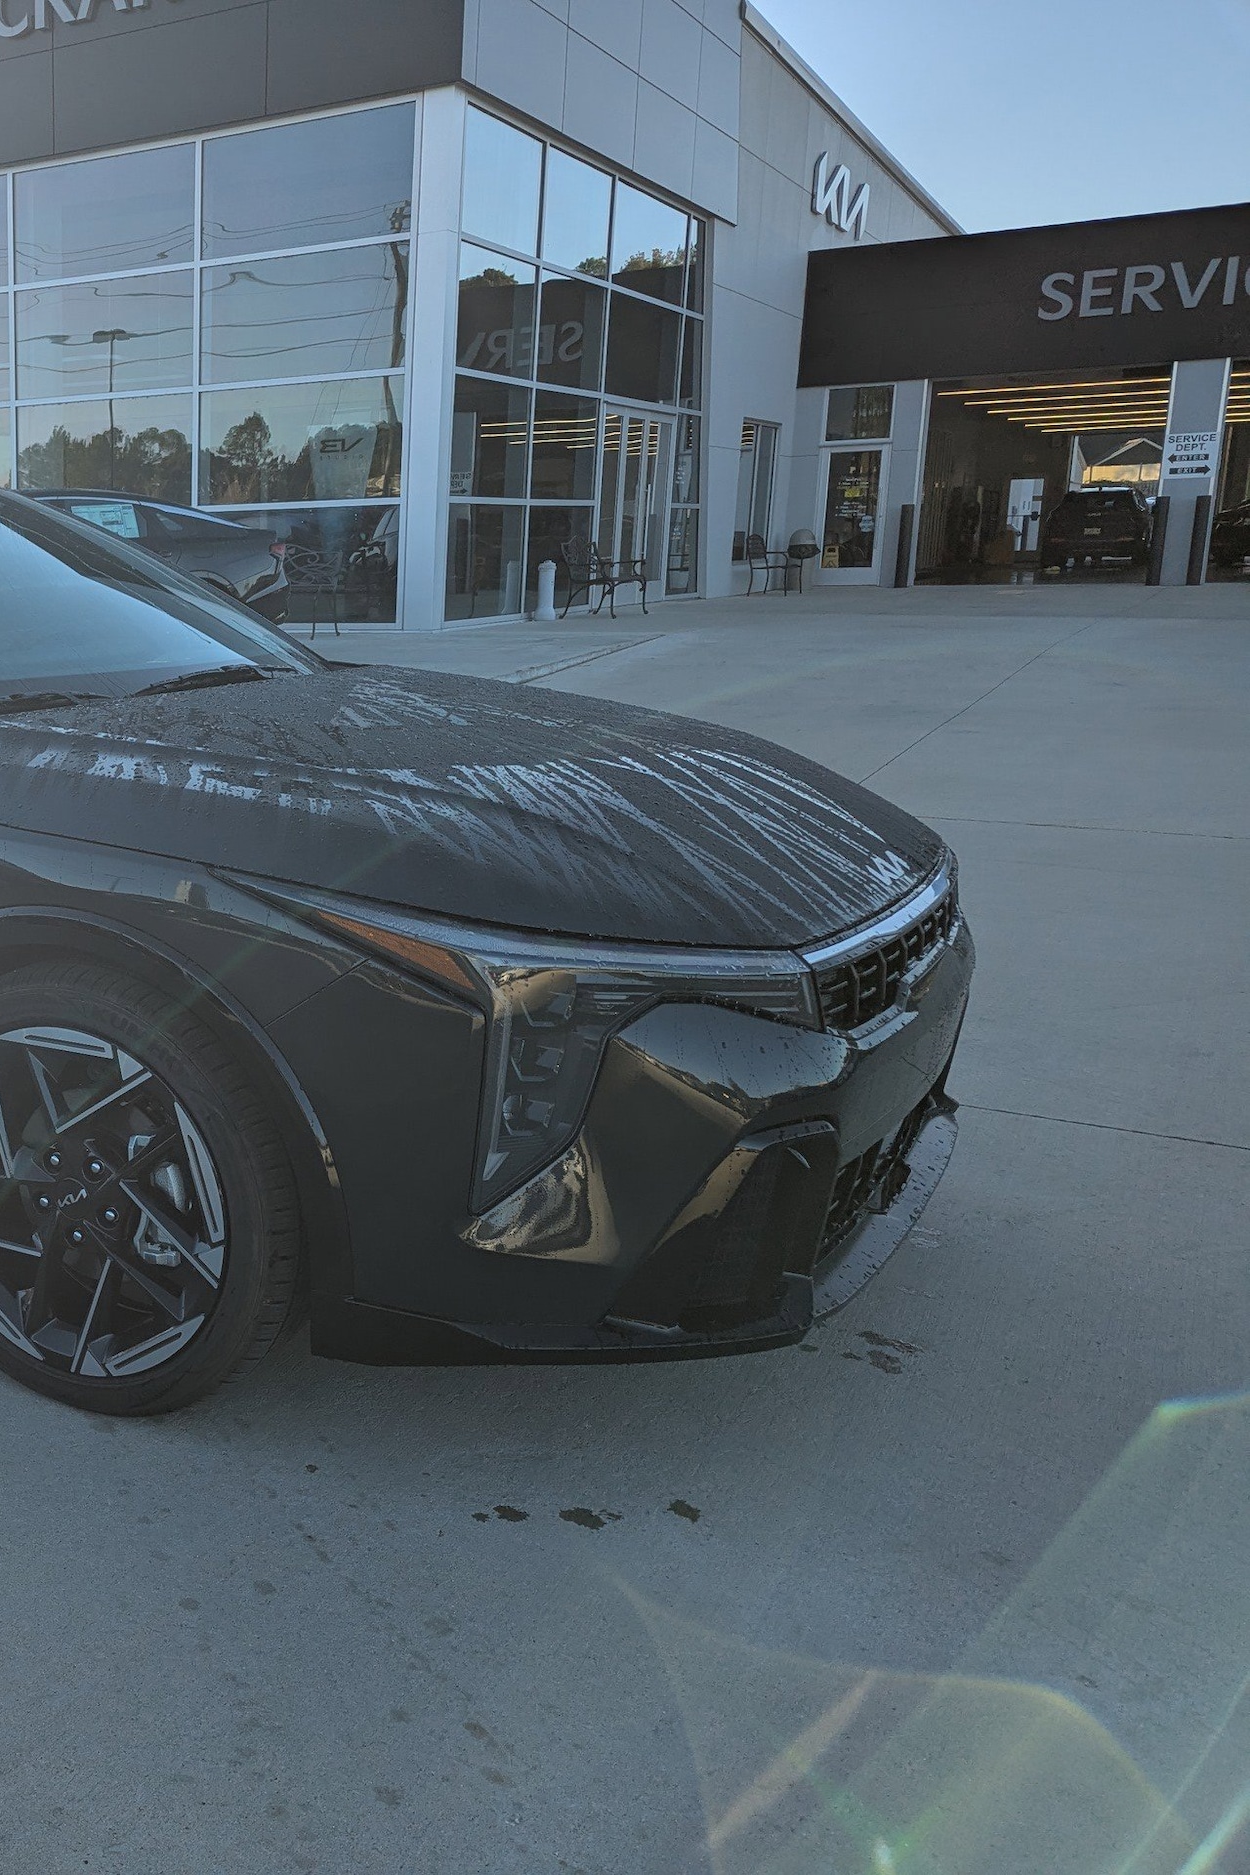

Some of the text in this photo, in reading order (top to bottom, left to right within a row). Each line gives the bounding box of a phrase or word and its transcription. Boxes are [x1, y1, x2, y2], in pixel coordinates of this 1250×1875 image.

[812, 151, 870, 240] KIA
[1037, 255, 1250, 321] SERVI
[1168, 434, 1217, 443] SERVICE
[1175, 443, 1207, 451] DEPT.
[58, 1189, 87, 1208] KIA
